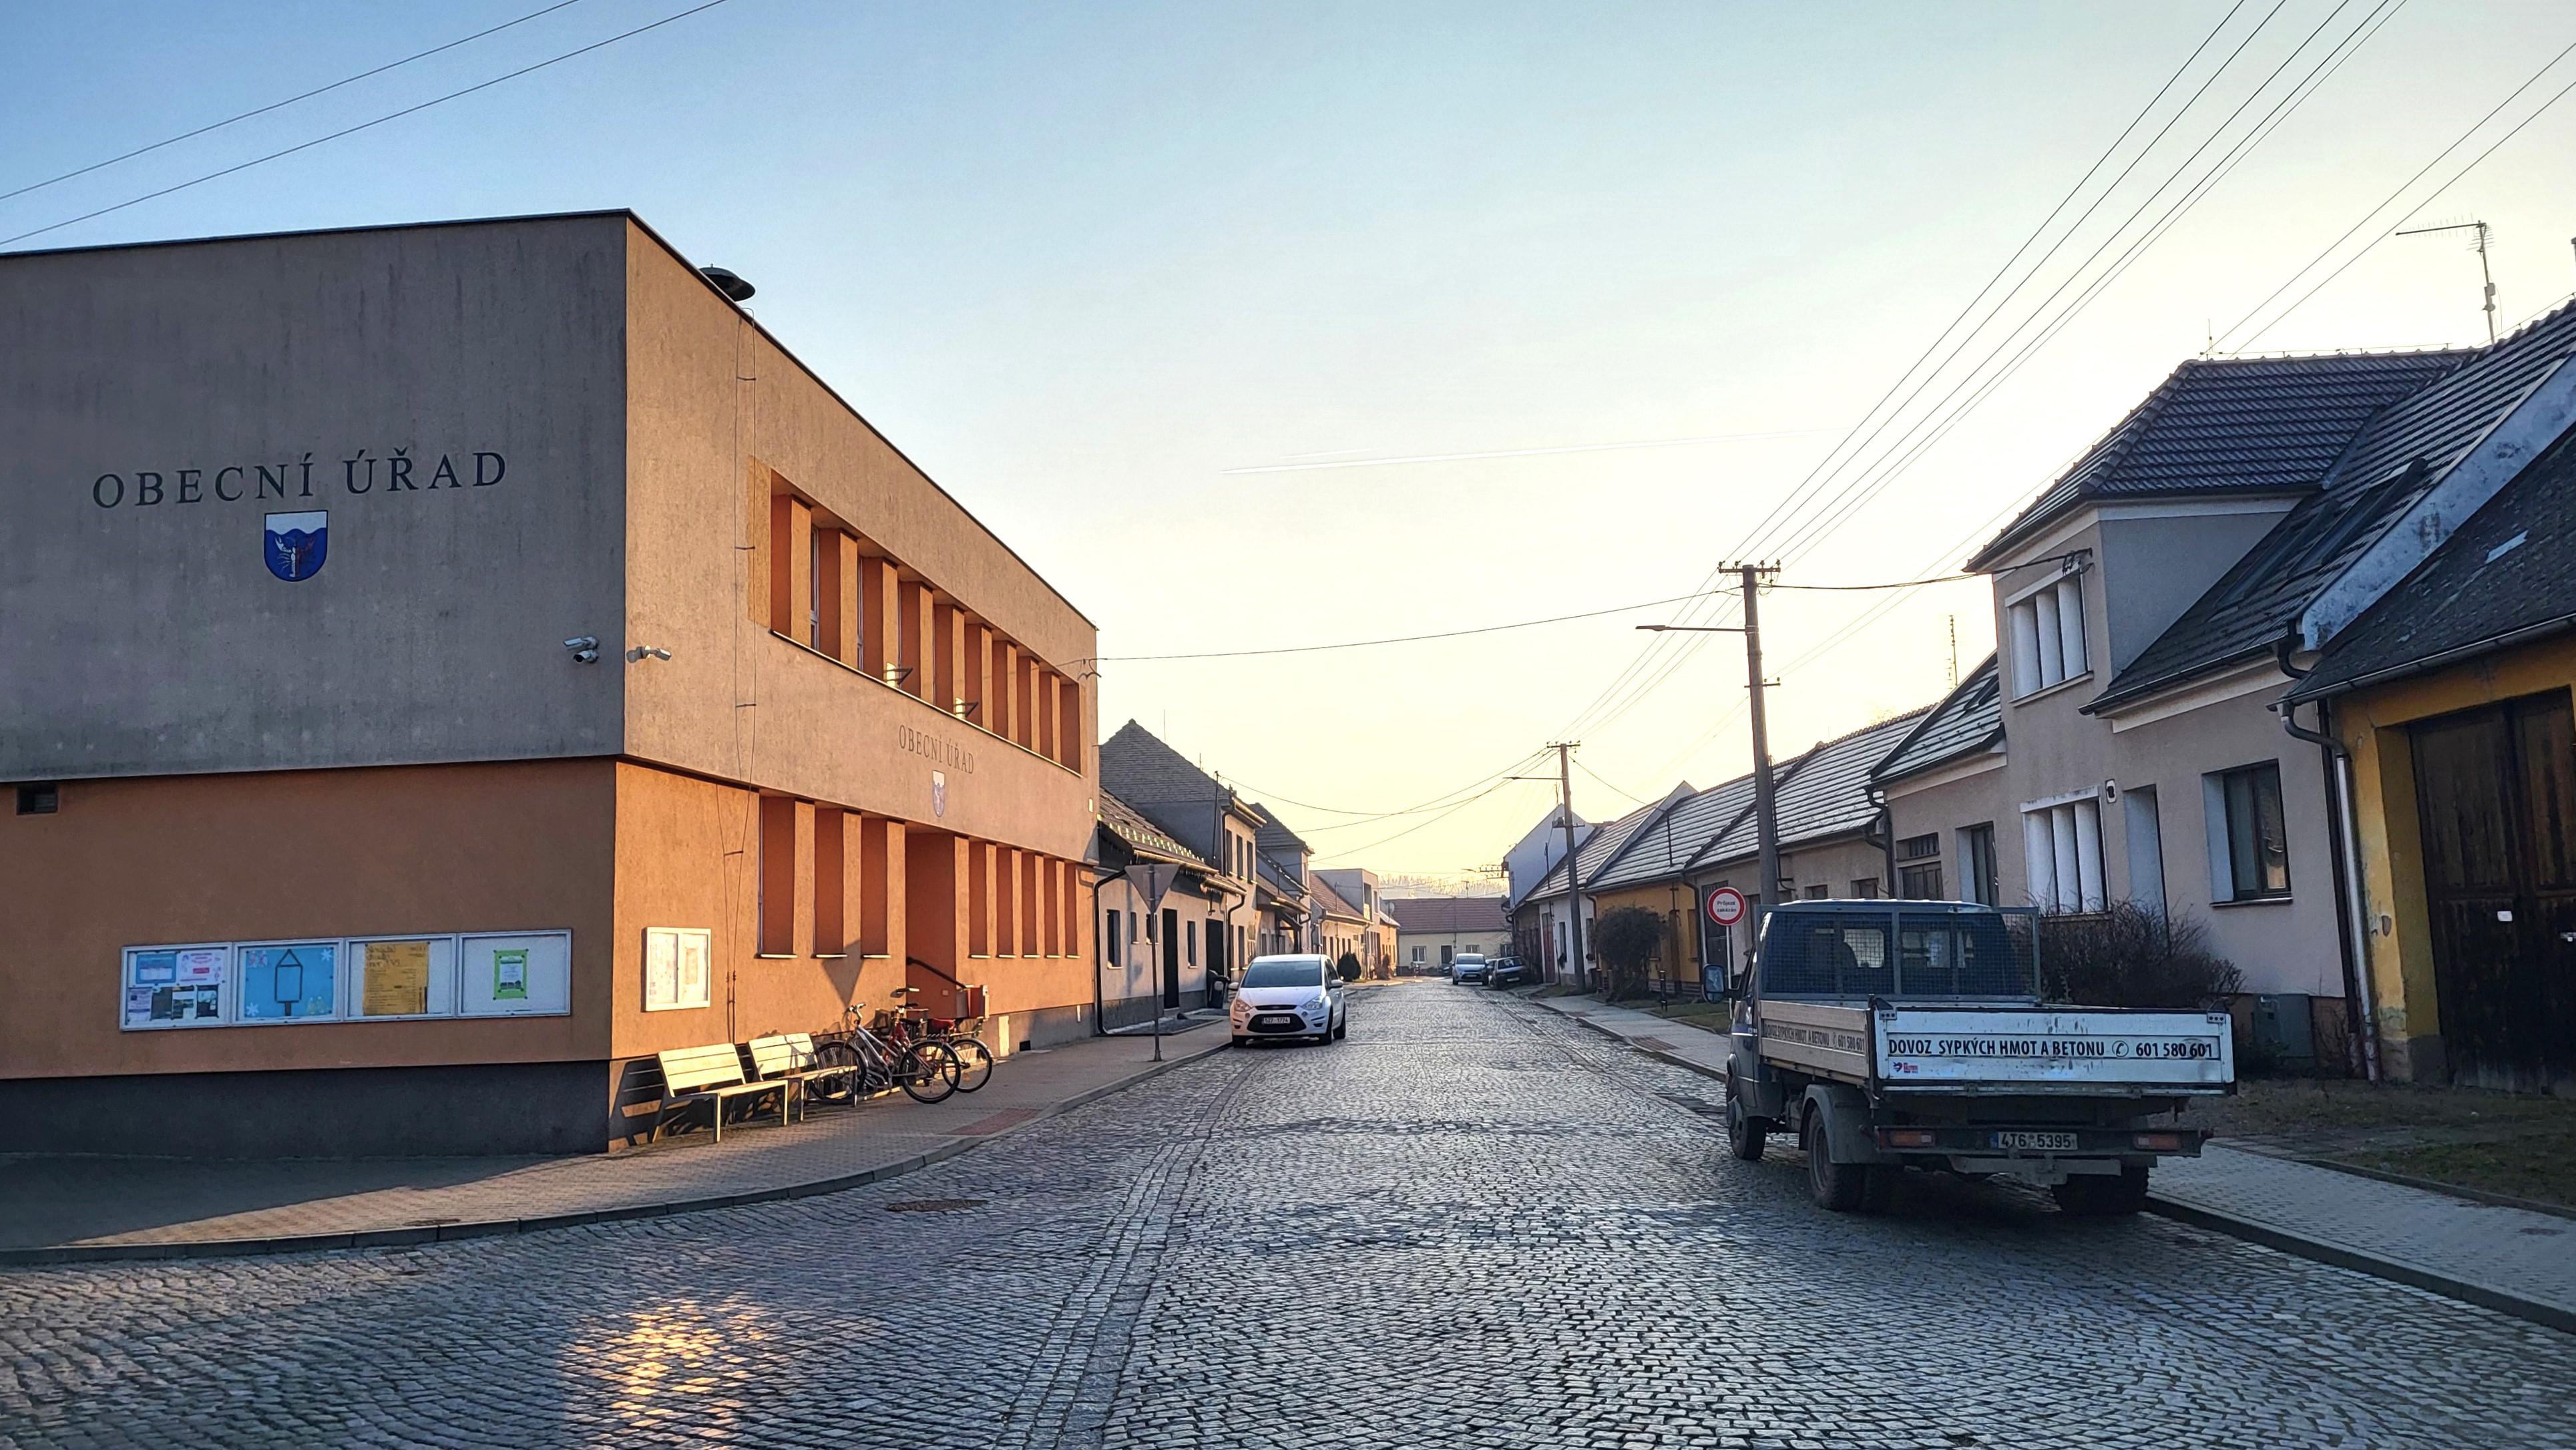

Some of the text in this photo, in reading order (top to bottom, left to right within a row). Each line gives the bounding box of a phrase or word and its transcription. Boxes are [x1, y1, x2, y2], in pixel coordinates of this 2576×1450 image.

[93, 446, 505, 508] OBECNÍ ÚŘAD
[899, 725, 974, 774] OBECNÍ ÚŘAD
[1848, 1035, 1856, 1050] 580
[1856, 1037, 1865, 1051] 601
[1889, 1037, 2212, 1057] DOVOZ SYPKÝCH HMOT A BETONU 601 580 601
[2037, 1135, 2071, 1148] 5395
